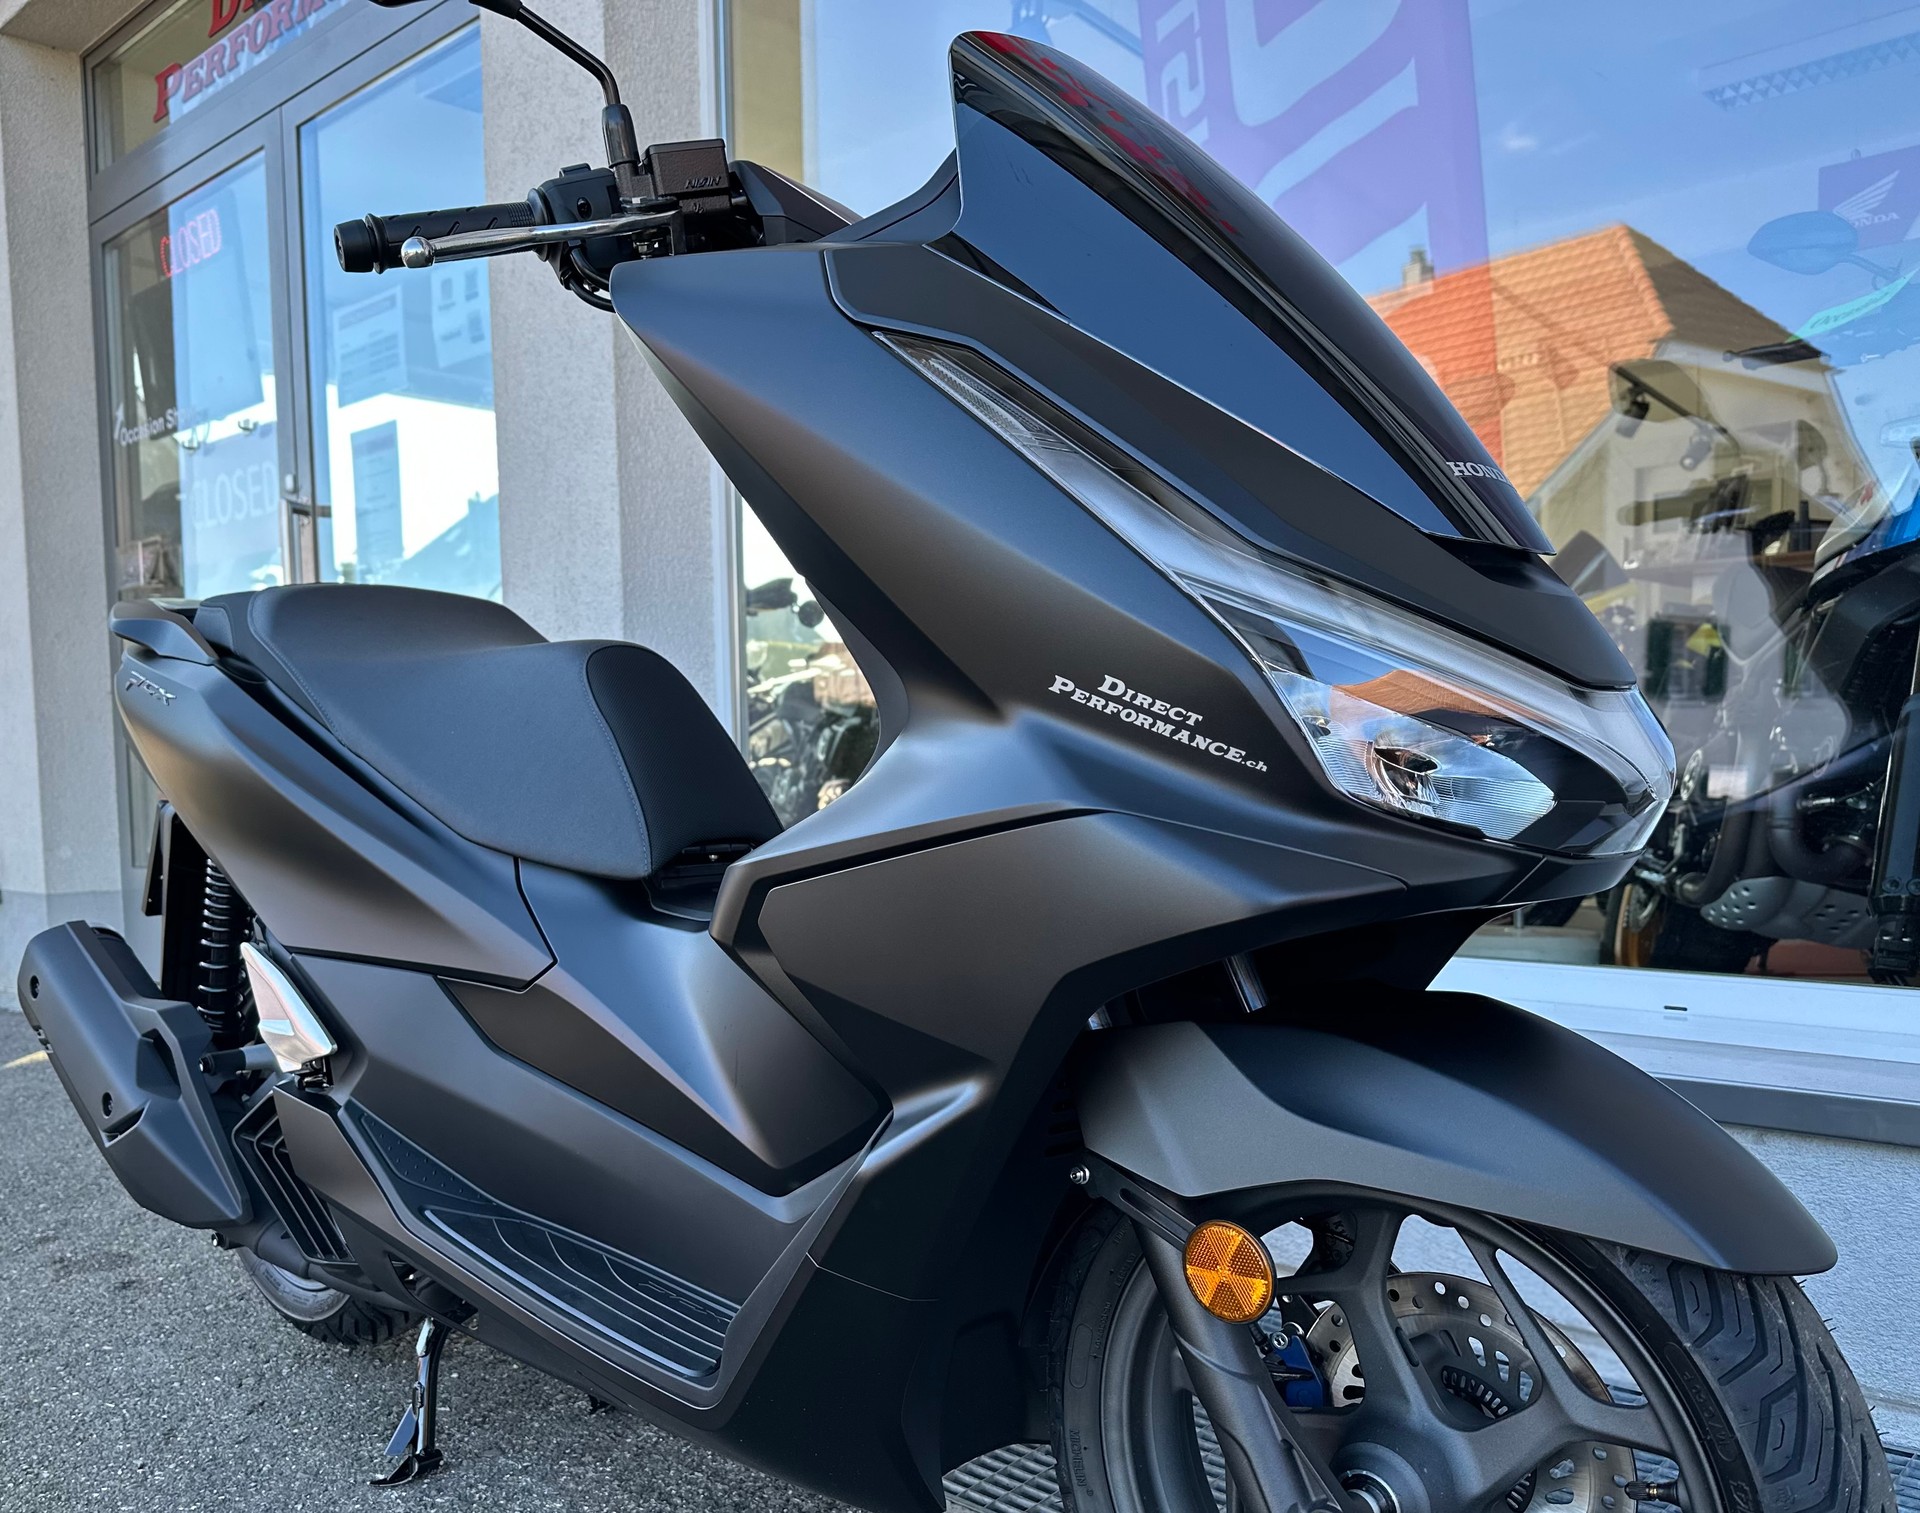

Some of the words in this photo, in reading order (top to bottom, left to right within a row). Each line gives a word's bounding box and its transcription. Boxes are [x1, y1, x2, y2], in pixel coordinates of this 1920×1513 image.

[160, 208, 222, 278] CLOSED
[1047, 674, 1269, 773] PERFORMANCE.ch
[1097, 674, 1203, 727] DIRECT
